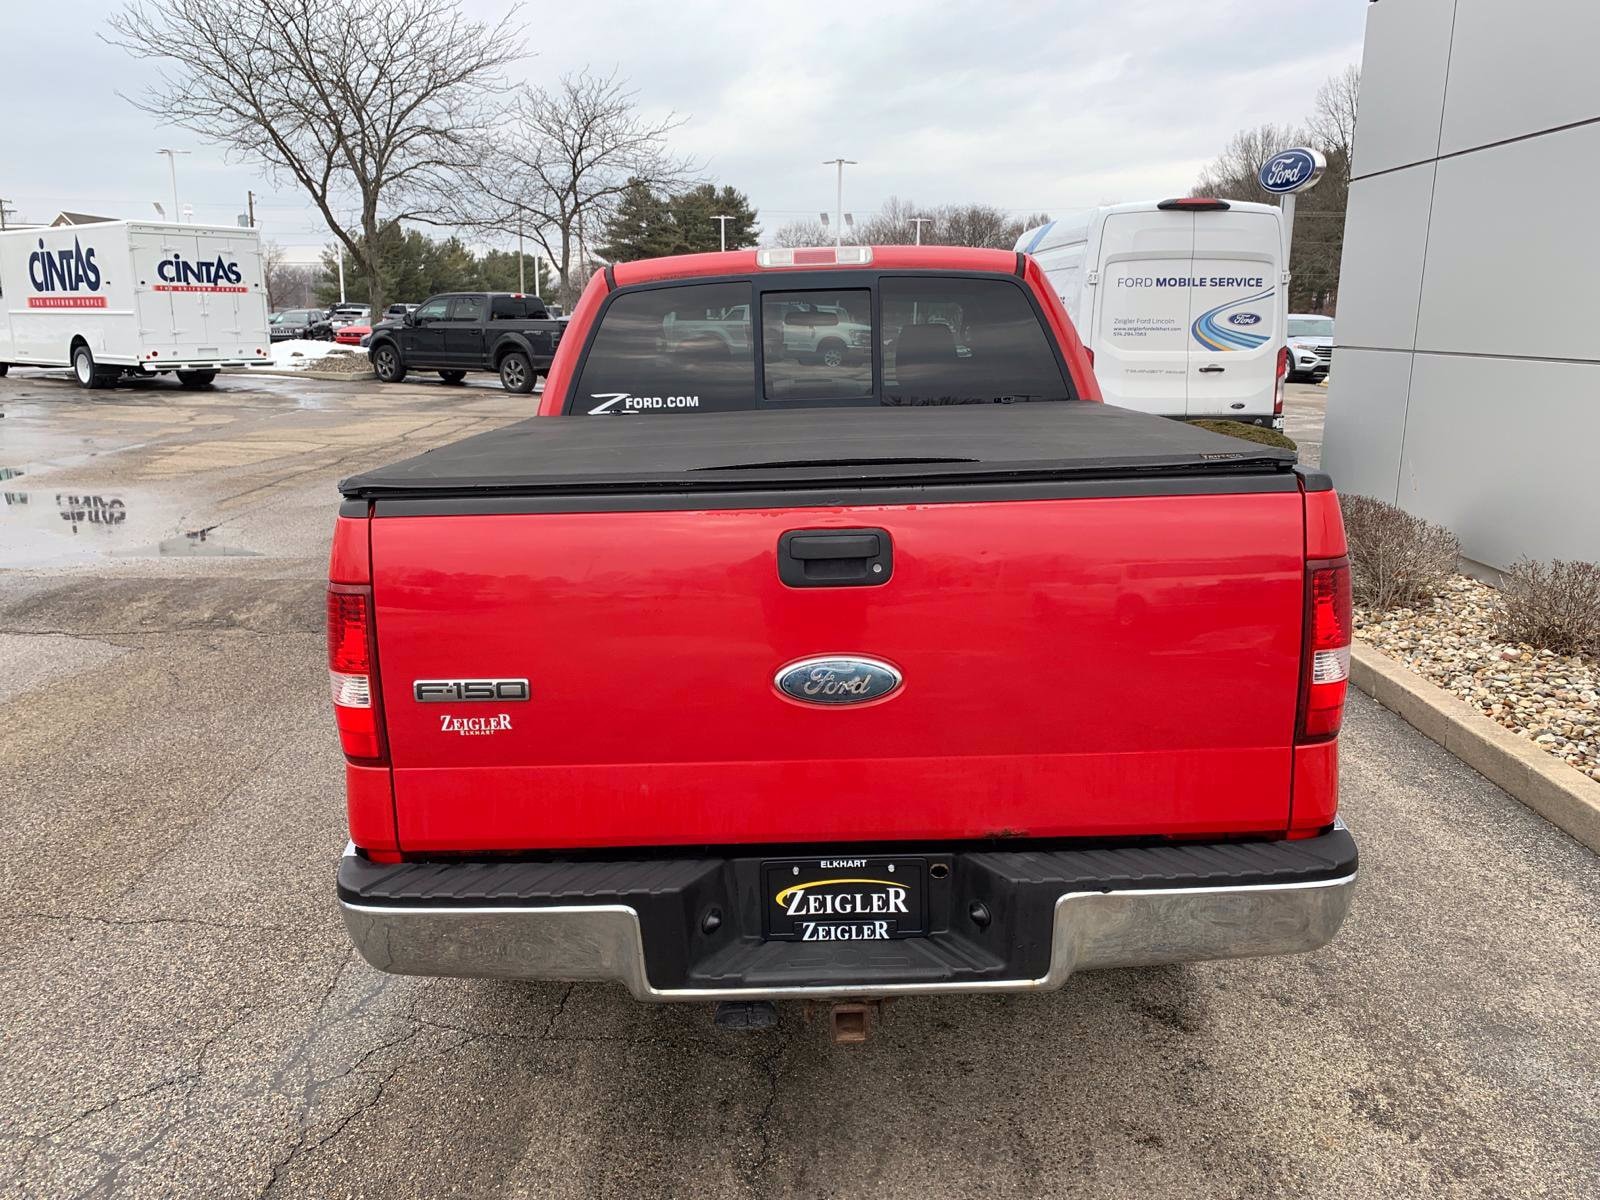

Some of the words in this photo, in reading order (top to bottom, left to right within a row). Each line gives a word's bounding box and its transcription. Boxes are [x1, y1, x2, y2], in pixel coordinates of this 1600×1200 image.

[1267, 157, 1302, 185] Ford
[1117, 277, 1153, 288] FORD
[1155, 277, 1207, 287] MOBILE
[1209, 277, 1263, 288] SERVICE
[1114, 318, 1136, 326] Zeigler
[804, 666, 872, 695] Ford
[416, 682, 526, 700] F-150
[440, 713, 512, 732] ZEIGLER
[820, 859, 867, 869] ELKHART
[786, 887, 909, 916] ZEIGLER
[802, 921, 890, 941] ZEIGLER
